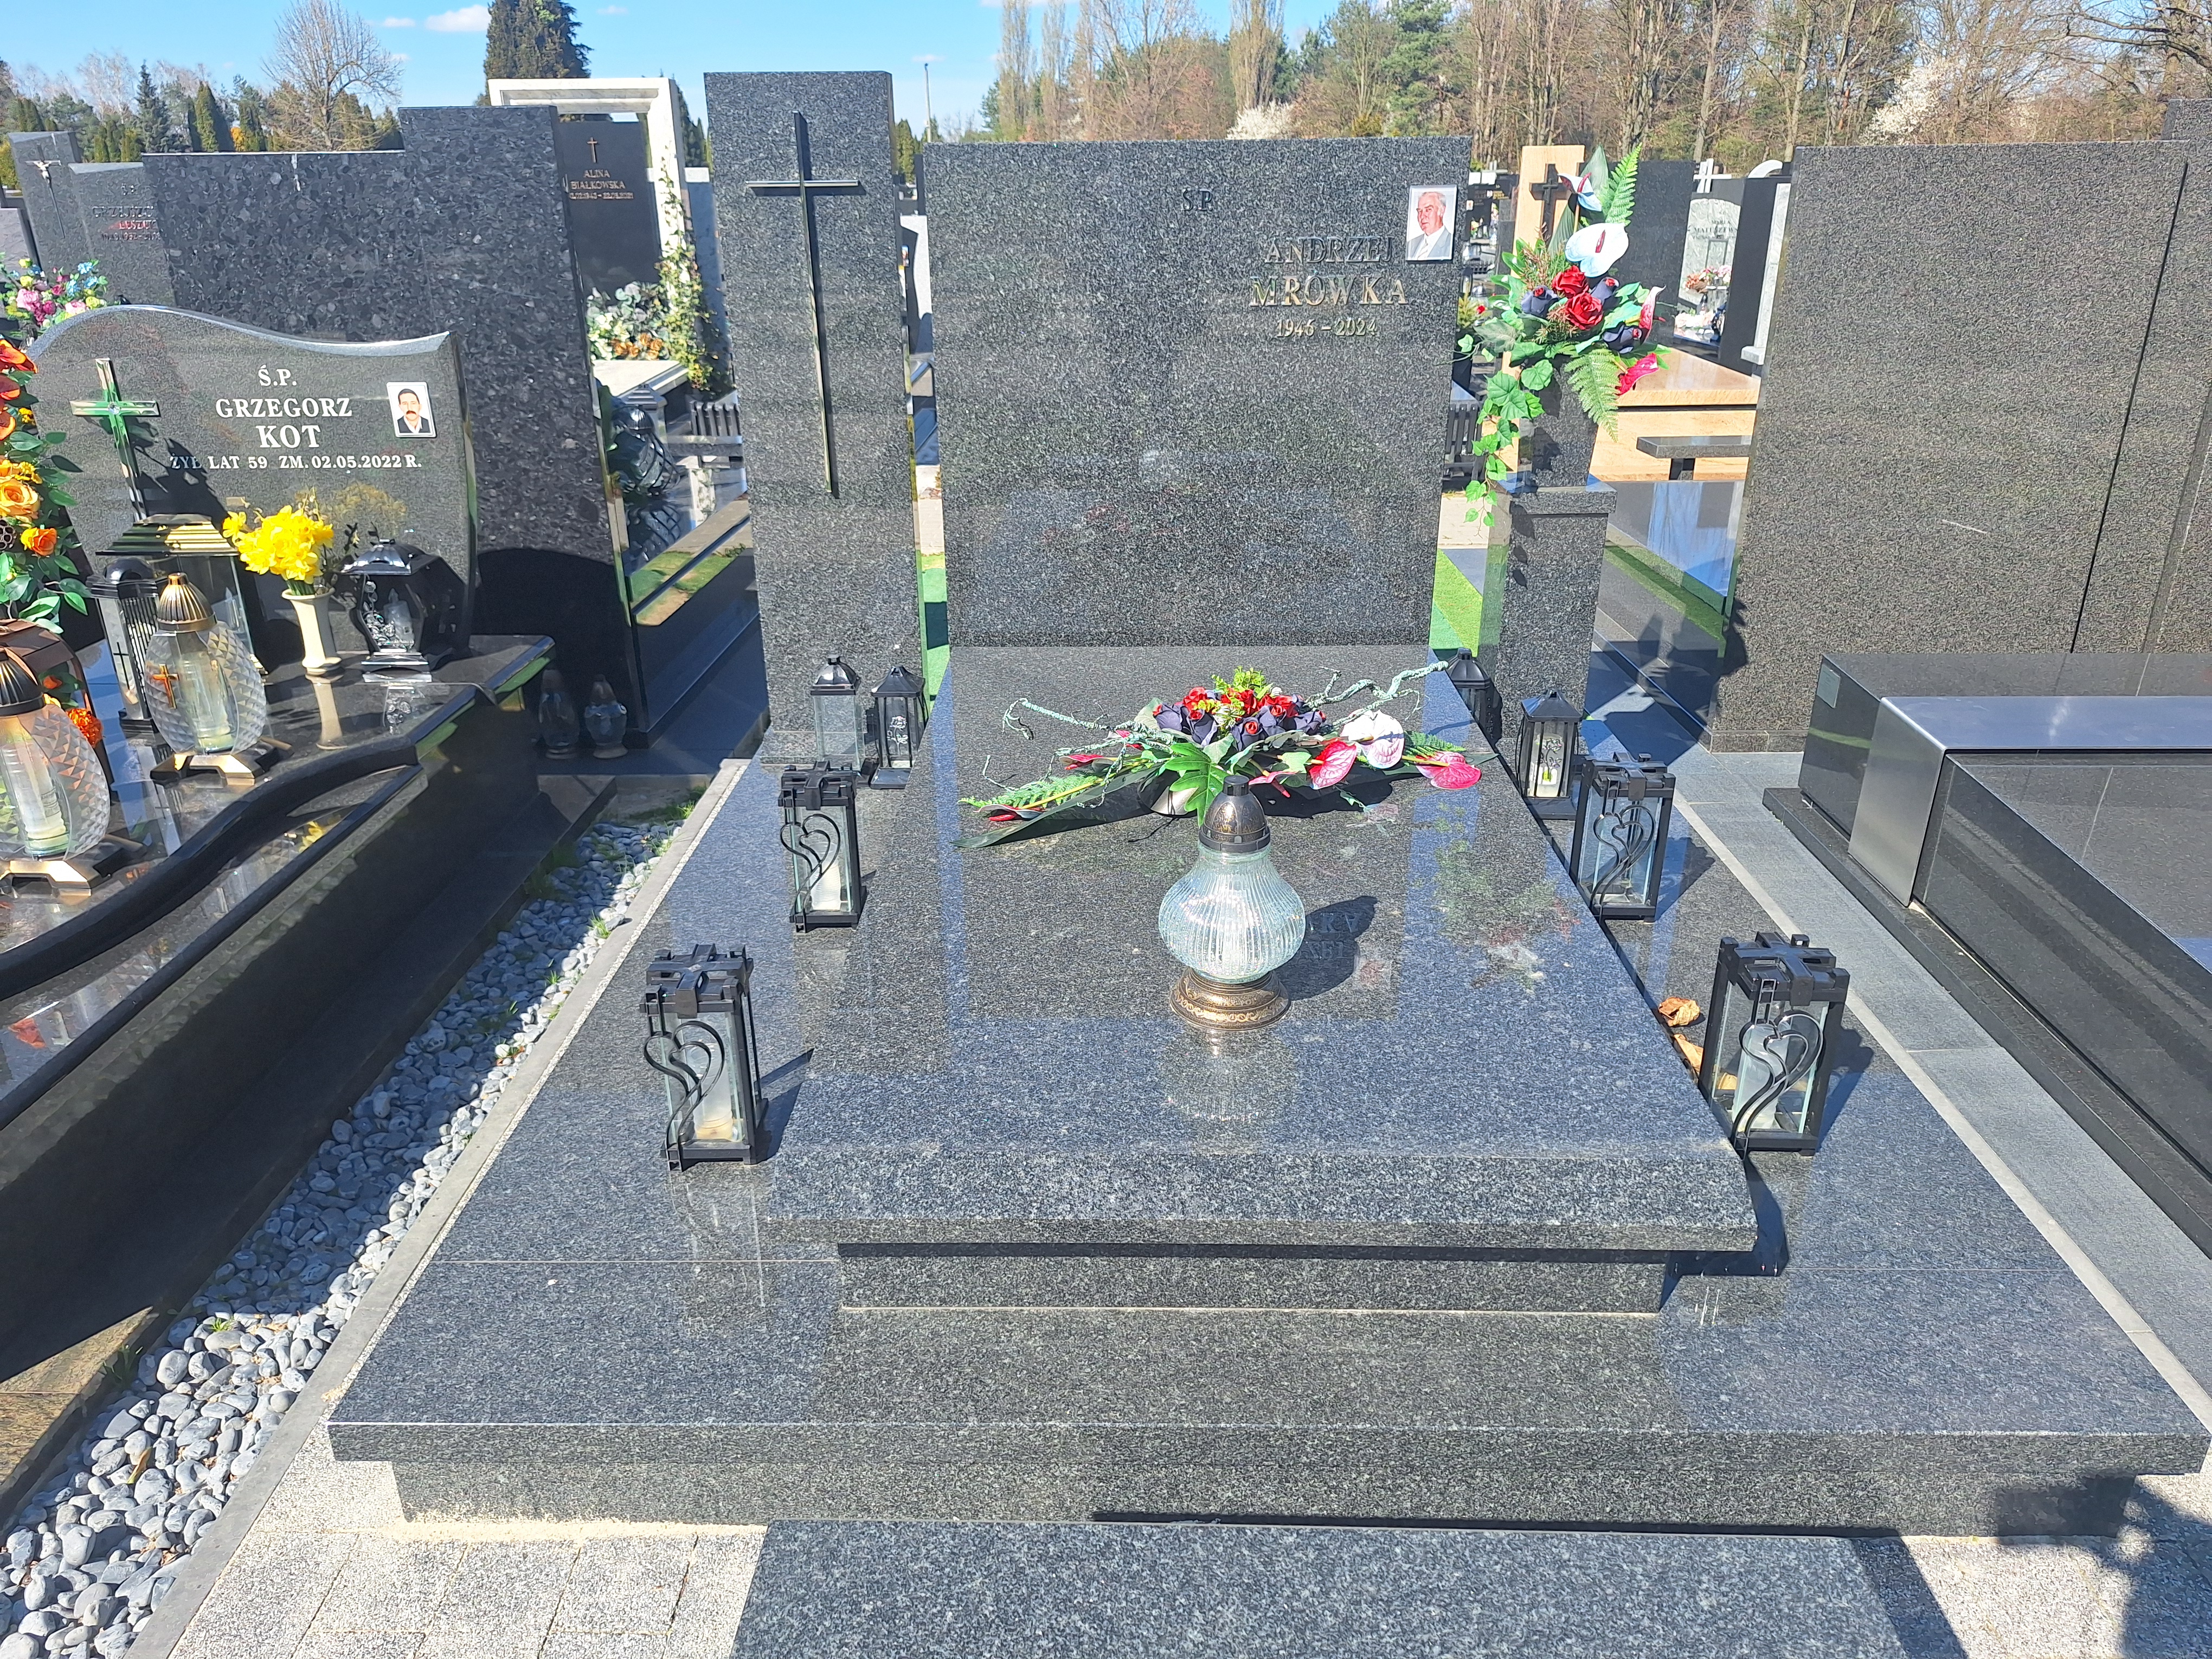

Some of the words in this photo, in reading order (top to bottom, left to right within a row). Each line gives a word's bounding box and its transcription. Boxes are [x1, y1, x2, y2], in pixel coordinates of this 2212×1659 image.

[583, 169, 610, 178] ALINA
[1265, 236, 1394, 263] ANDRZEJ
[1276, 319, 1316, 337] 1946
[1334, 317, 1377, 336] 2024
[258, 364, 297, 386] Ś.P.
[216, 397, 352, 417] GRZEGORZ
[256, 425, 321, 448] KOT
[208, 455, 240, 469] LAT
[248, 456, 267, 469] 59
[279, 455, 309, 468] ZM.
[311, 455, 402, 468] 02.05.2022
[405, 454, 422, 468] R.
